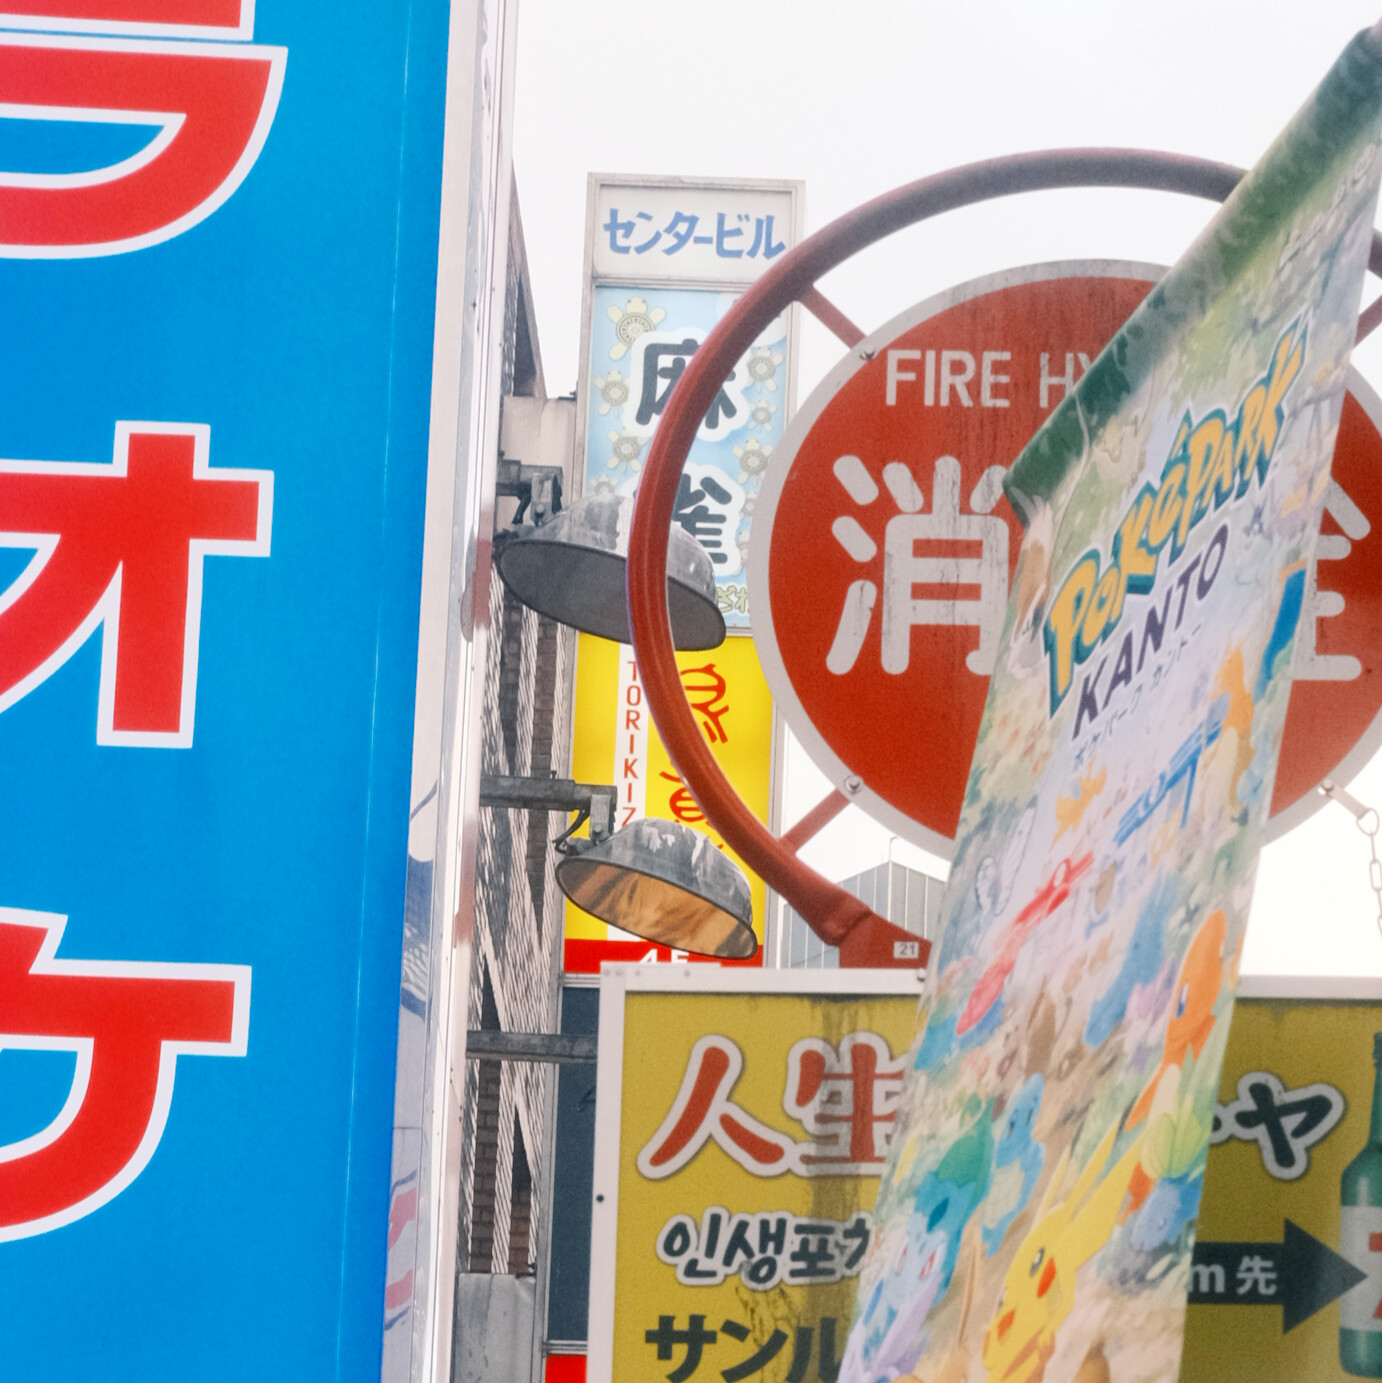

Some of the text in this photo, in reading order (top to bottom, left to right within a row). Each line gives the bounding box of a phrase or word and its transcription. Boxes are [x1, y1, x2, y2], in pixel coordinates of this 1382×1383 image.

[602, 207, 787, 261] センタービル
[885, 350, 1012, 408] FIRE
[1072, 523, 1229, 741] KANTO
